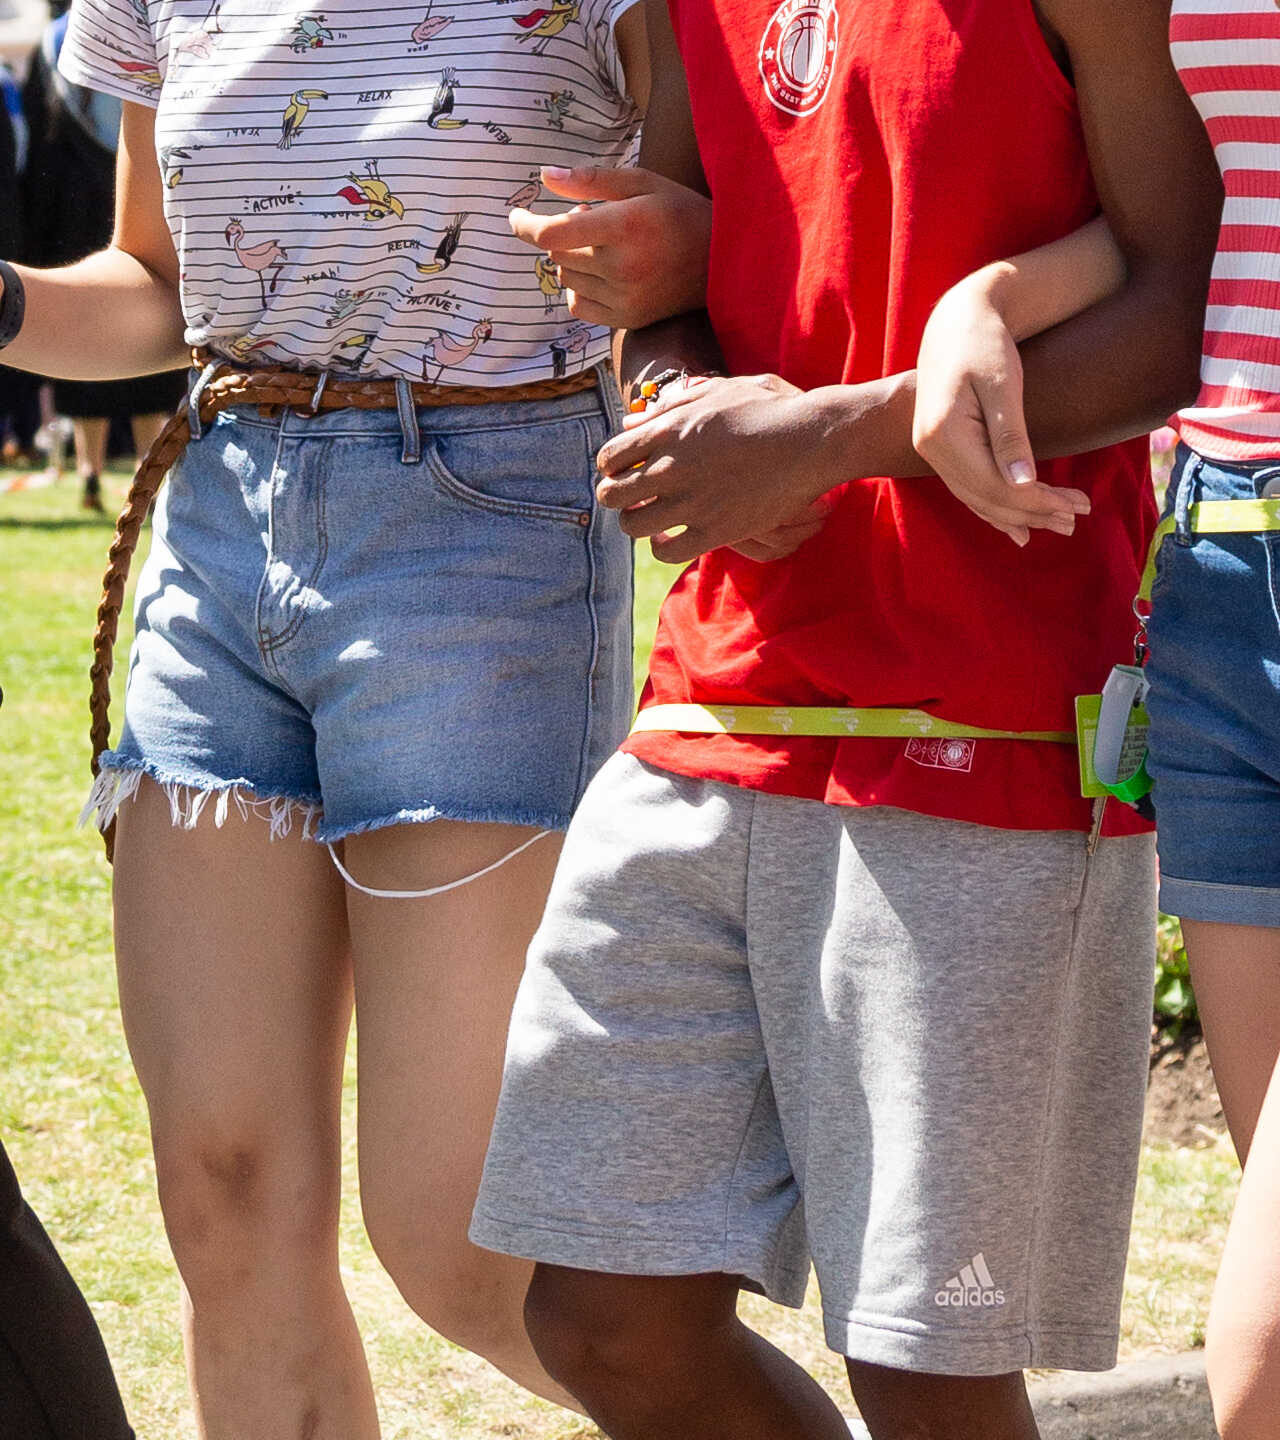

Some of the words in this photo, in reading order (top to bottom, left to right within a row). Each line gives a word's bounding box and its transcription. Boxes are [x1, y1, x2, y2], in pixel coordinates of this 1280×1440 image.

[357, 90, 393, 104] RELAX
[483, 120, 512, 145] RELAX
[252, 194, 295, 213] ACTIVE
[388, 239, 421, 254] RELAX
[407, 296, 451, 312] ACTIVE
[935, 1287, 1006, 1307] adidas
